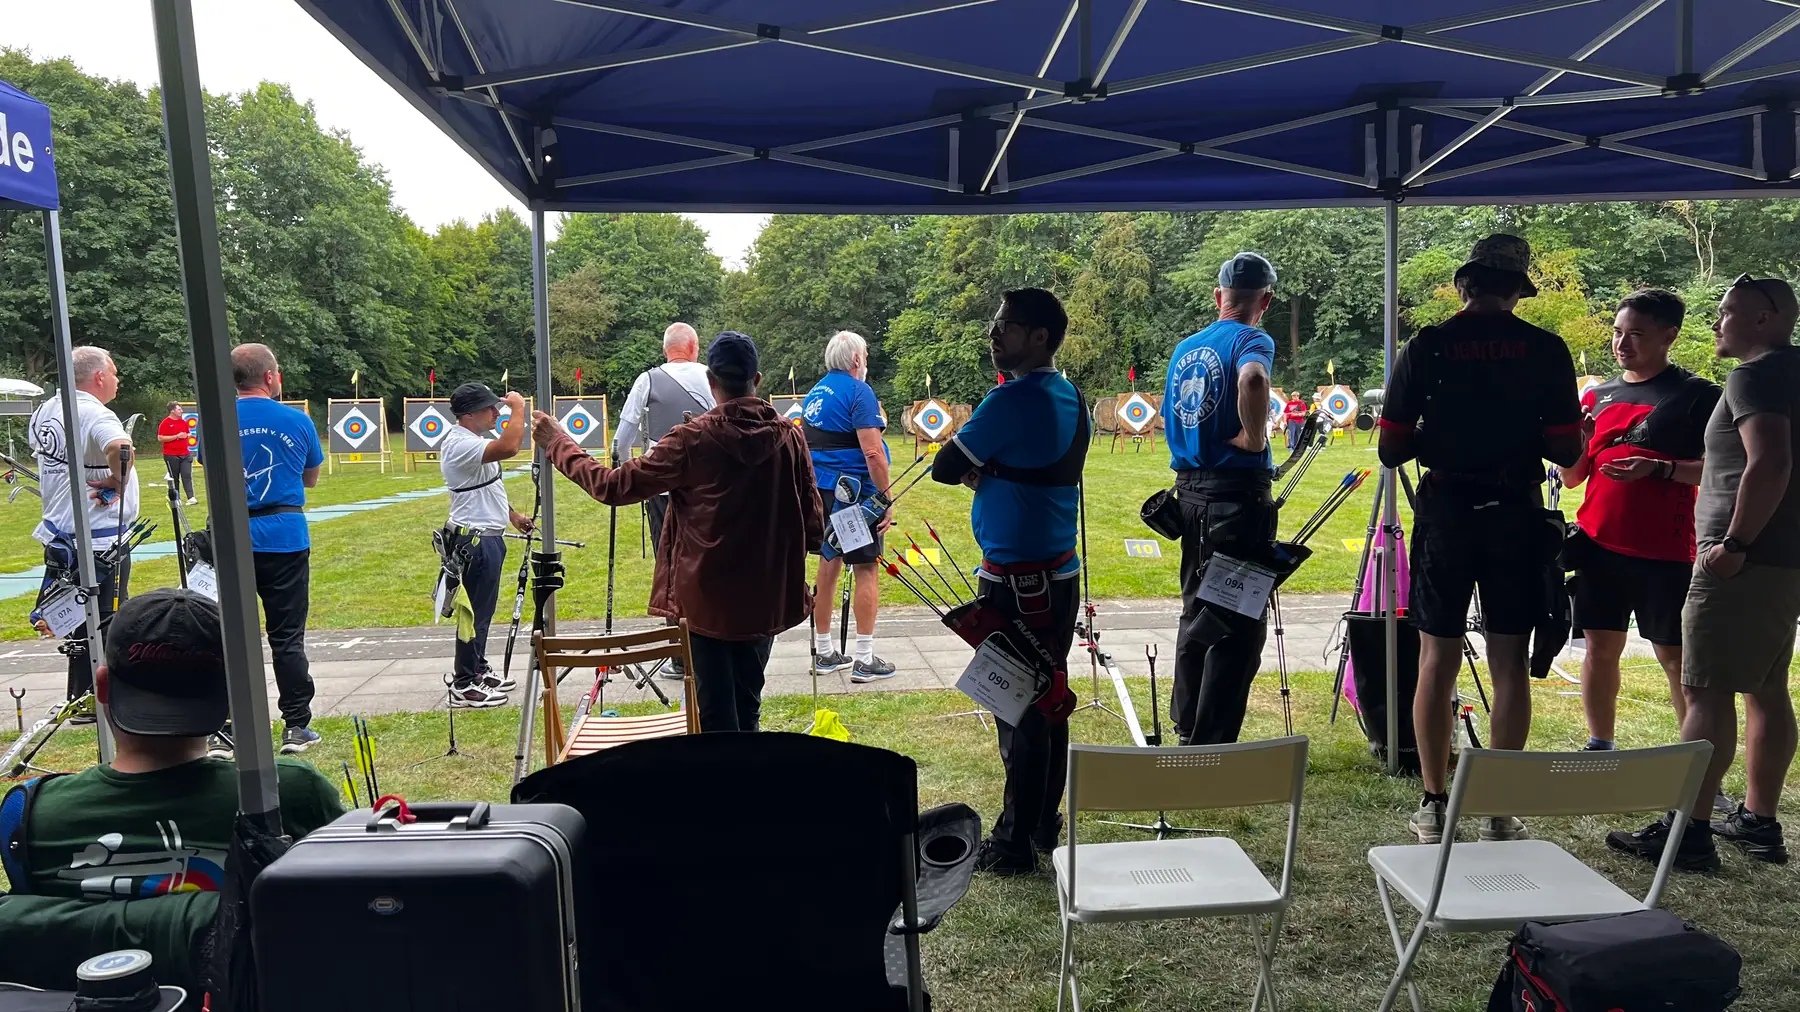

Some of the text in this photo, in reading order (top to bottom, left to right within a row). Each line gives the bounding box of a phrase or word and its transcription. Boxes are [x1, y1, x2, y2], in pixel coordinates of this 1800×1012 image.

[1177, 351, 1198, 371] 1890
[1199, 350, 1221, 382] BRAKEL
[279, 432, 294, 448] 1882
[1132, 544, 1154, 555] 10
[197, 579, 212, 591] 07C
[1224, 577, 1245, 592] 09A
[57, 607, 73, 619] 07A
[1012, 619, 1058, 667] AVALON
[988, 671, 1010, 690] 09D
